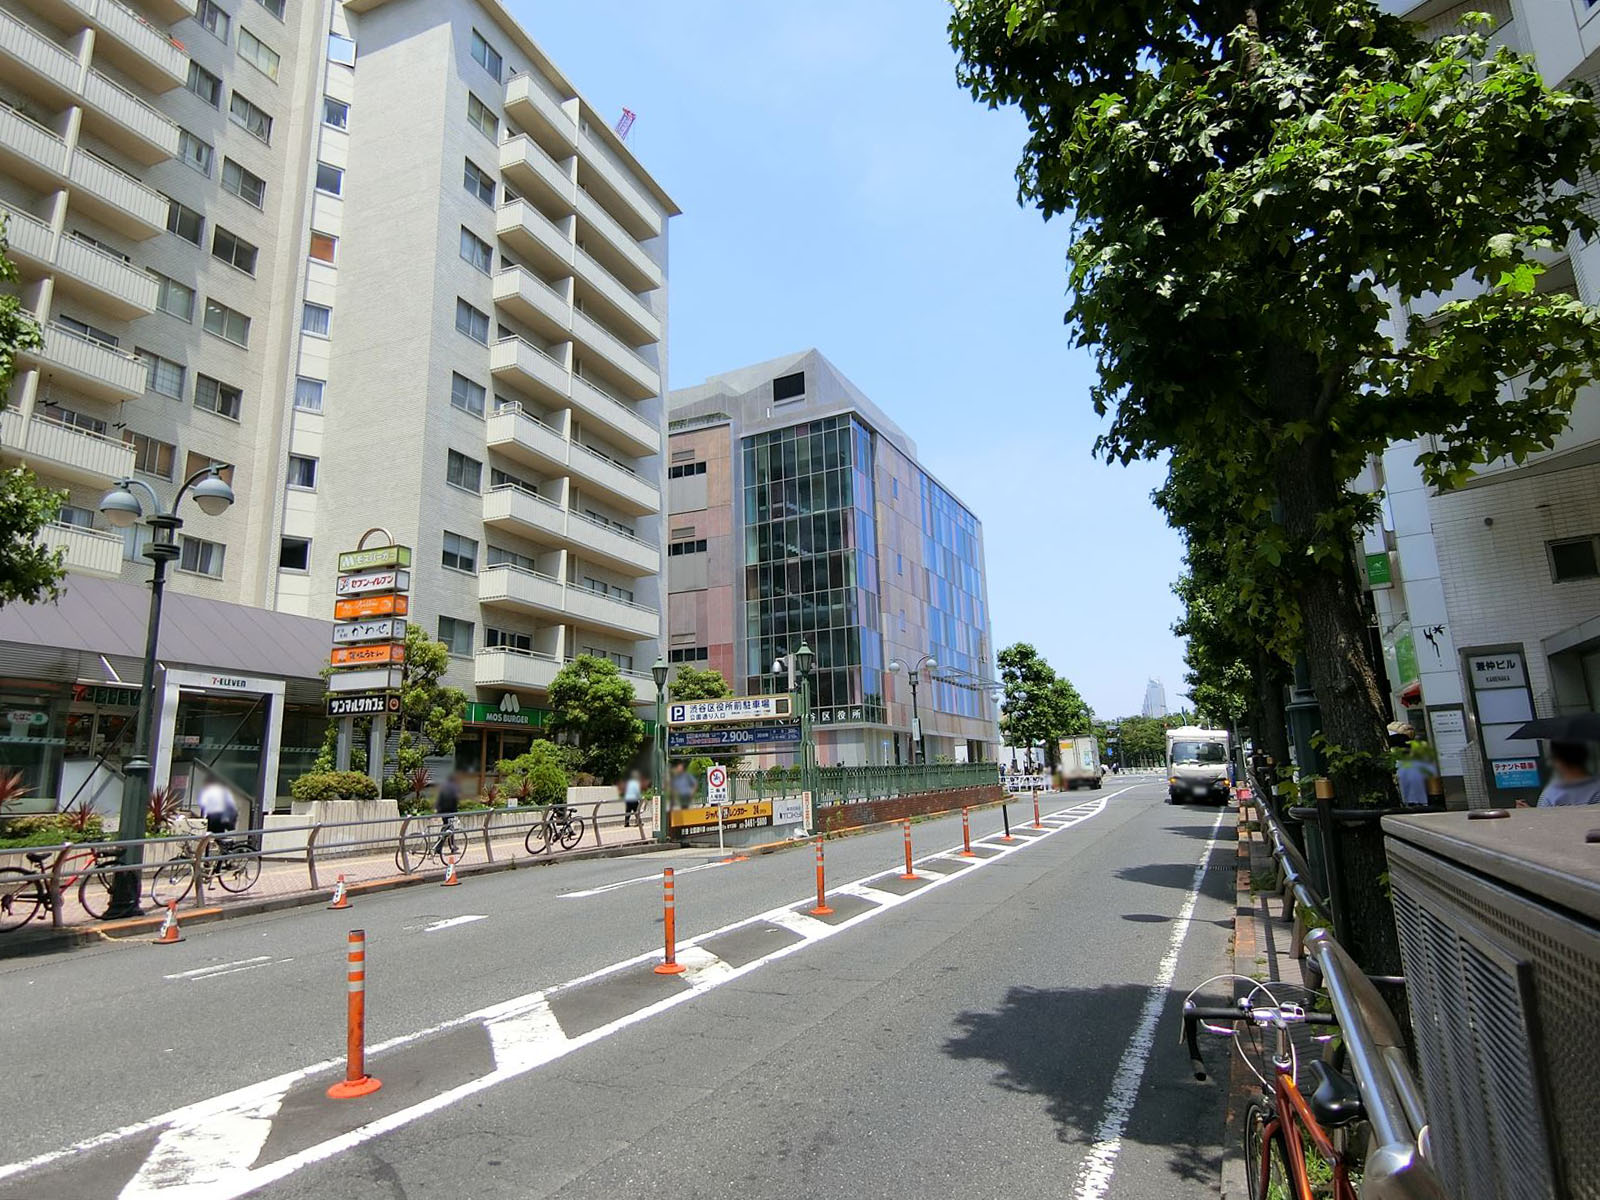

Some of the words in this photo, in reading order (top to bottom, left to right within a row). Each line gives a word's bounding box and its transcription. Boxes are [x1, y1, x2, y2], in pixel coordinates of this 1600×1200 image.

[331, 697, 384, 713] サンマルクカフェ
[690, 700, 770, 714] 渋谷区役所前駐車場
[486, 713, 502, 722] MOS
[503, 714, 529, 724] BURGER
